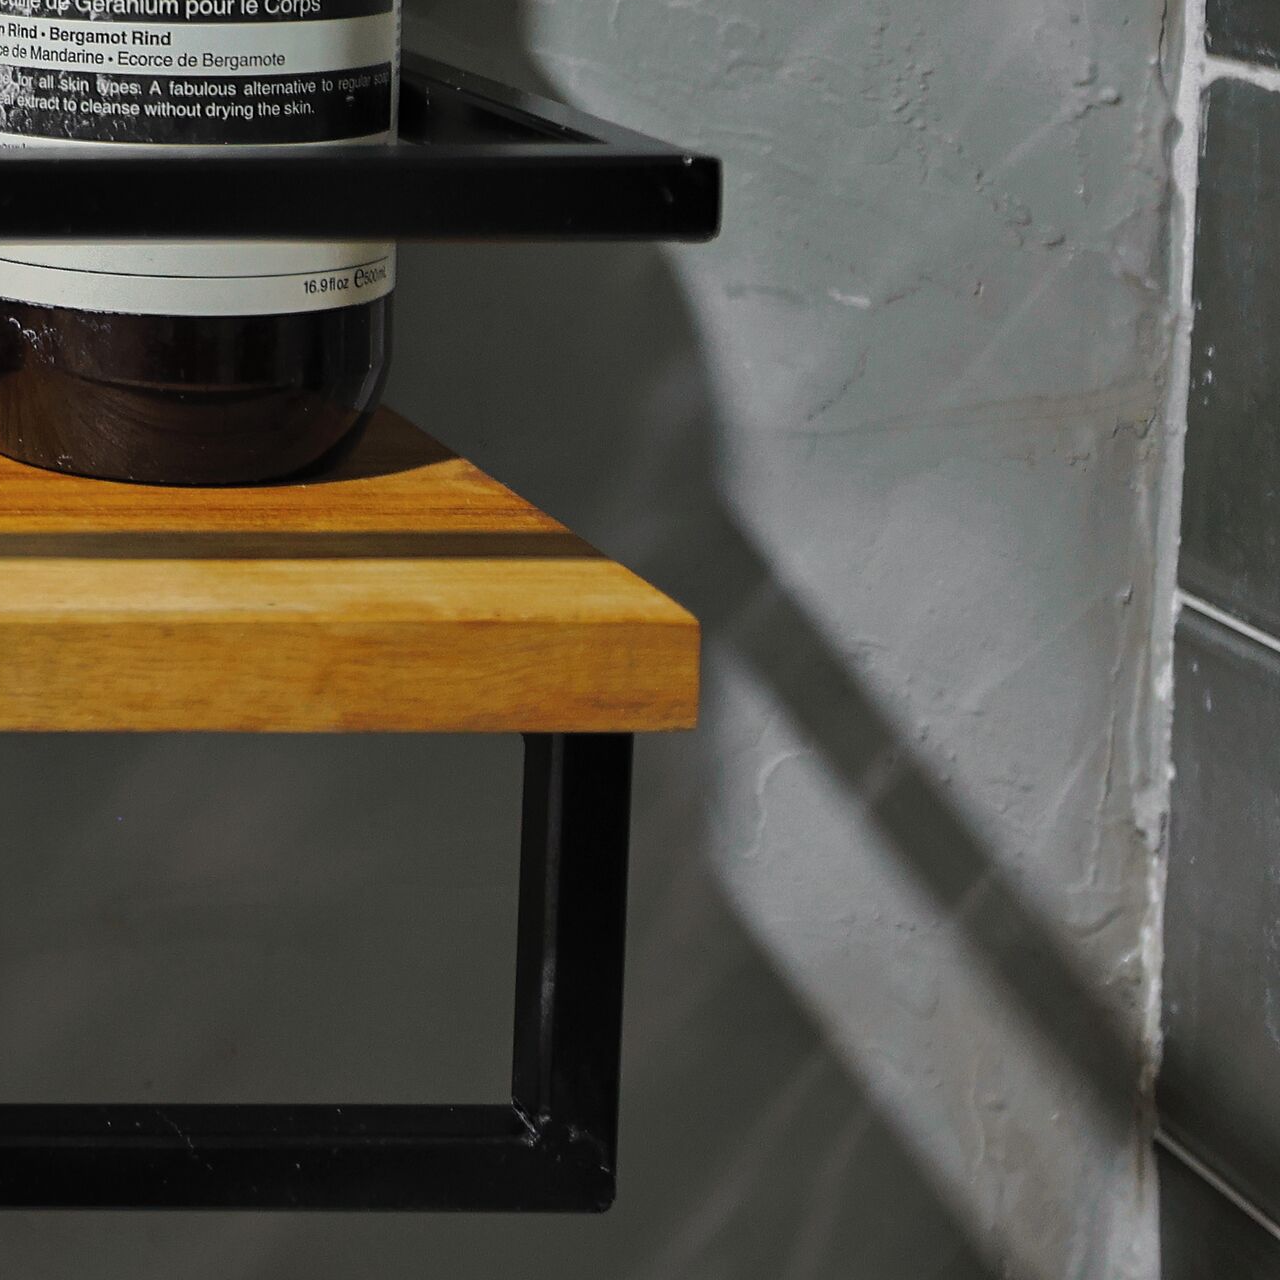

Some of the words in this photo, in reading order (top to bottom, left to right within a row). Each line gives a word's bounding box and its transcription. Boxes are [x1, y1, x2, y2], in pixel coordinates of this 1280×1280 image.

[8, 23, 37, 39] Rind
[50, 27, 127, 46] Bergamot
[132, 31, 172, 46] Rind
[12, 44, 27, 59] de
[30, 47, 104, 65] Mandarine
[118, 51, 173, 67] Ecorce
[178, 53, 198, 67] de
[202, 53, 285, 71] Bergamote
[18, 74, 34, 88] for
[39, 75, 54, 89] all
[60, 77, 89, 92] skin
[149, 81, 162, 95] A
[169, 80, 237, 96] fabulous
[243, 79, 316, 96] alternative
[322, 78, 334, 92] to
[338, 74, 371, 92] regular
[17, 94, 60, 111] extract
[63, 98, 77, 112] to
[80, 100, 140, 116] cleanse
[144, 101, 201, 117] without
[205, 102, 254, 120] drying
[258, 101, 281, 116] the
[284, 101, 315, 116] skin.
